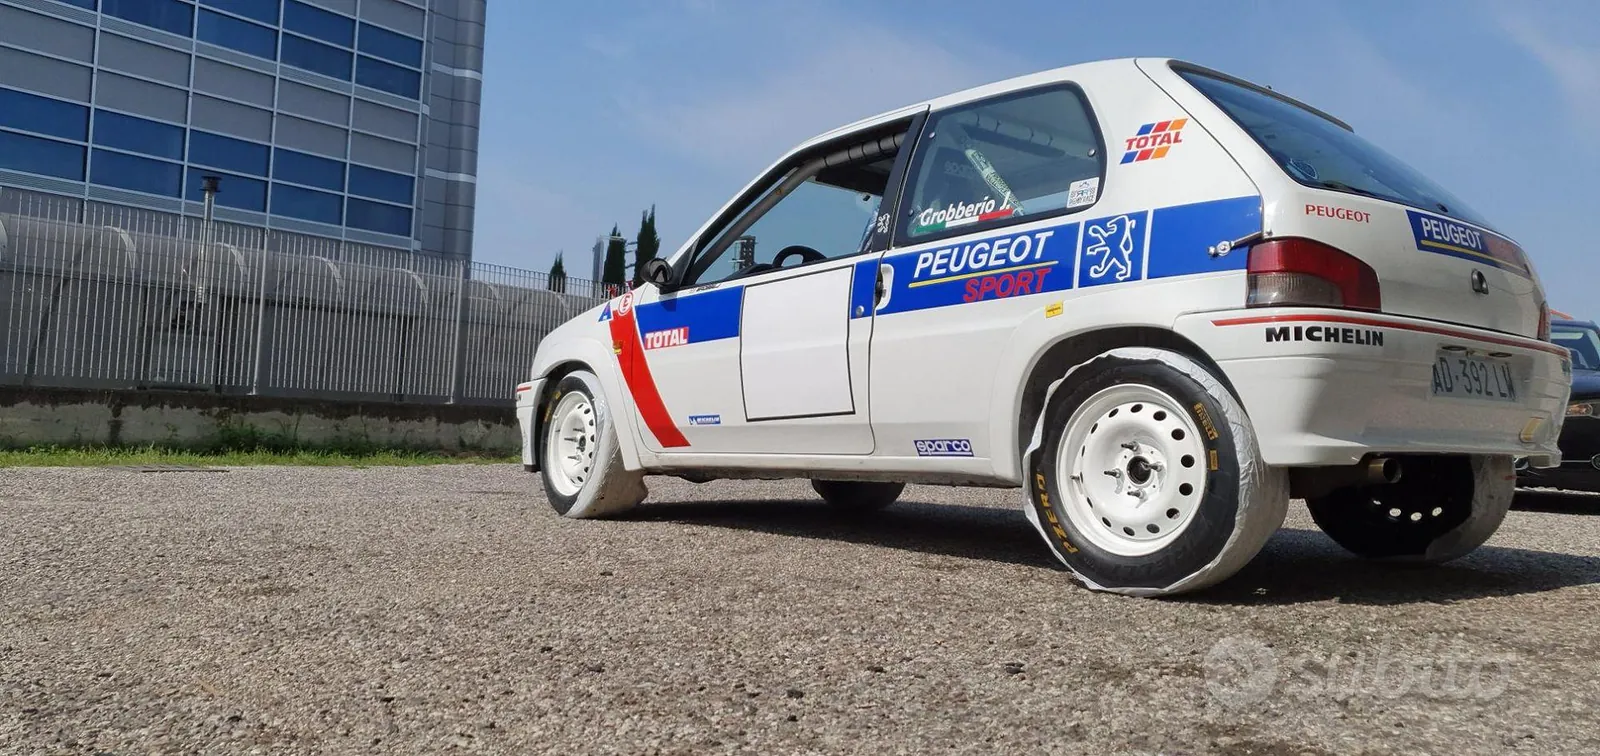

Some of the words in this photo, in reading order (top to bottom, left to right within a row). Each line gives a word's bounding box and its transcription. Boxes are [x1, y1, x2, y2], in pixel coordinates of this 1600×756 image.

[1126, 131, 1182, 150] TOTAL
[919, 196, 995, 226] Grobberio
[1305, 204, 1371, 223] PEUGEOT
[1421, 217, 1482, 250] PEUGEOT
[913, 231, 1054, 278] PEUGEOT
[963, 268, 1051, 302] SPORT
[645, 328, 688, 349] TOTAL
[1265, 326, 1384, 346] MICHELIN
[916, 440, 970, 455] sparco
